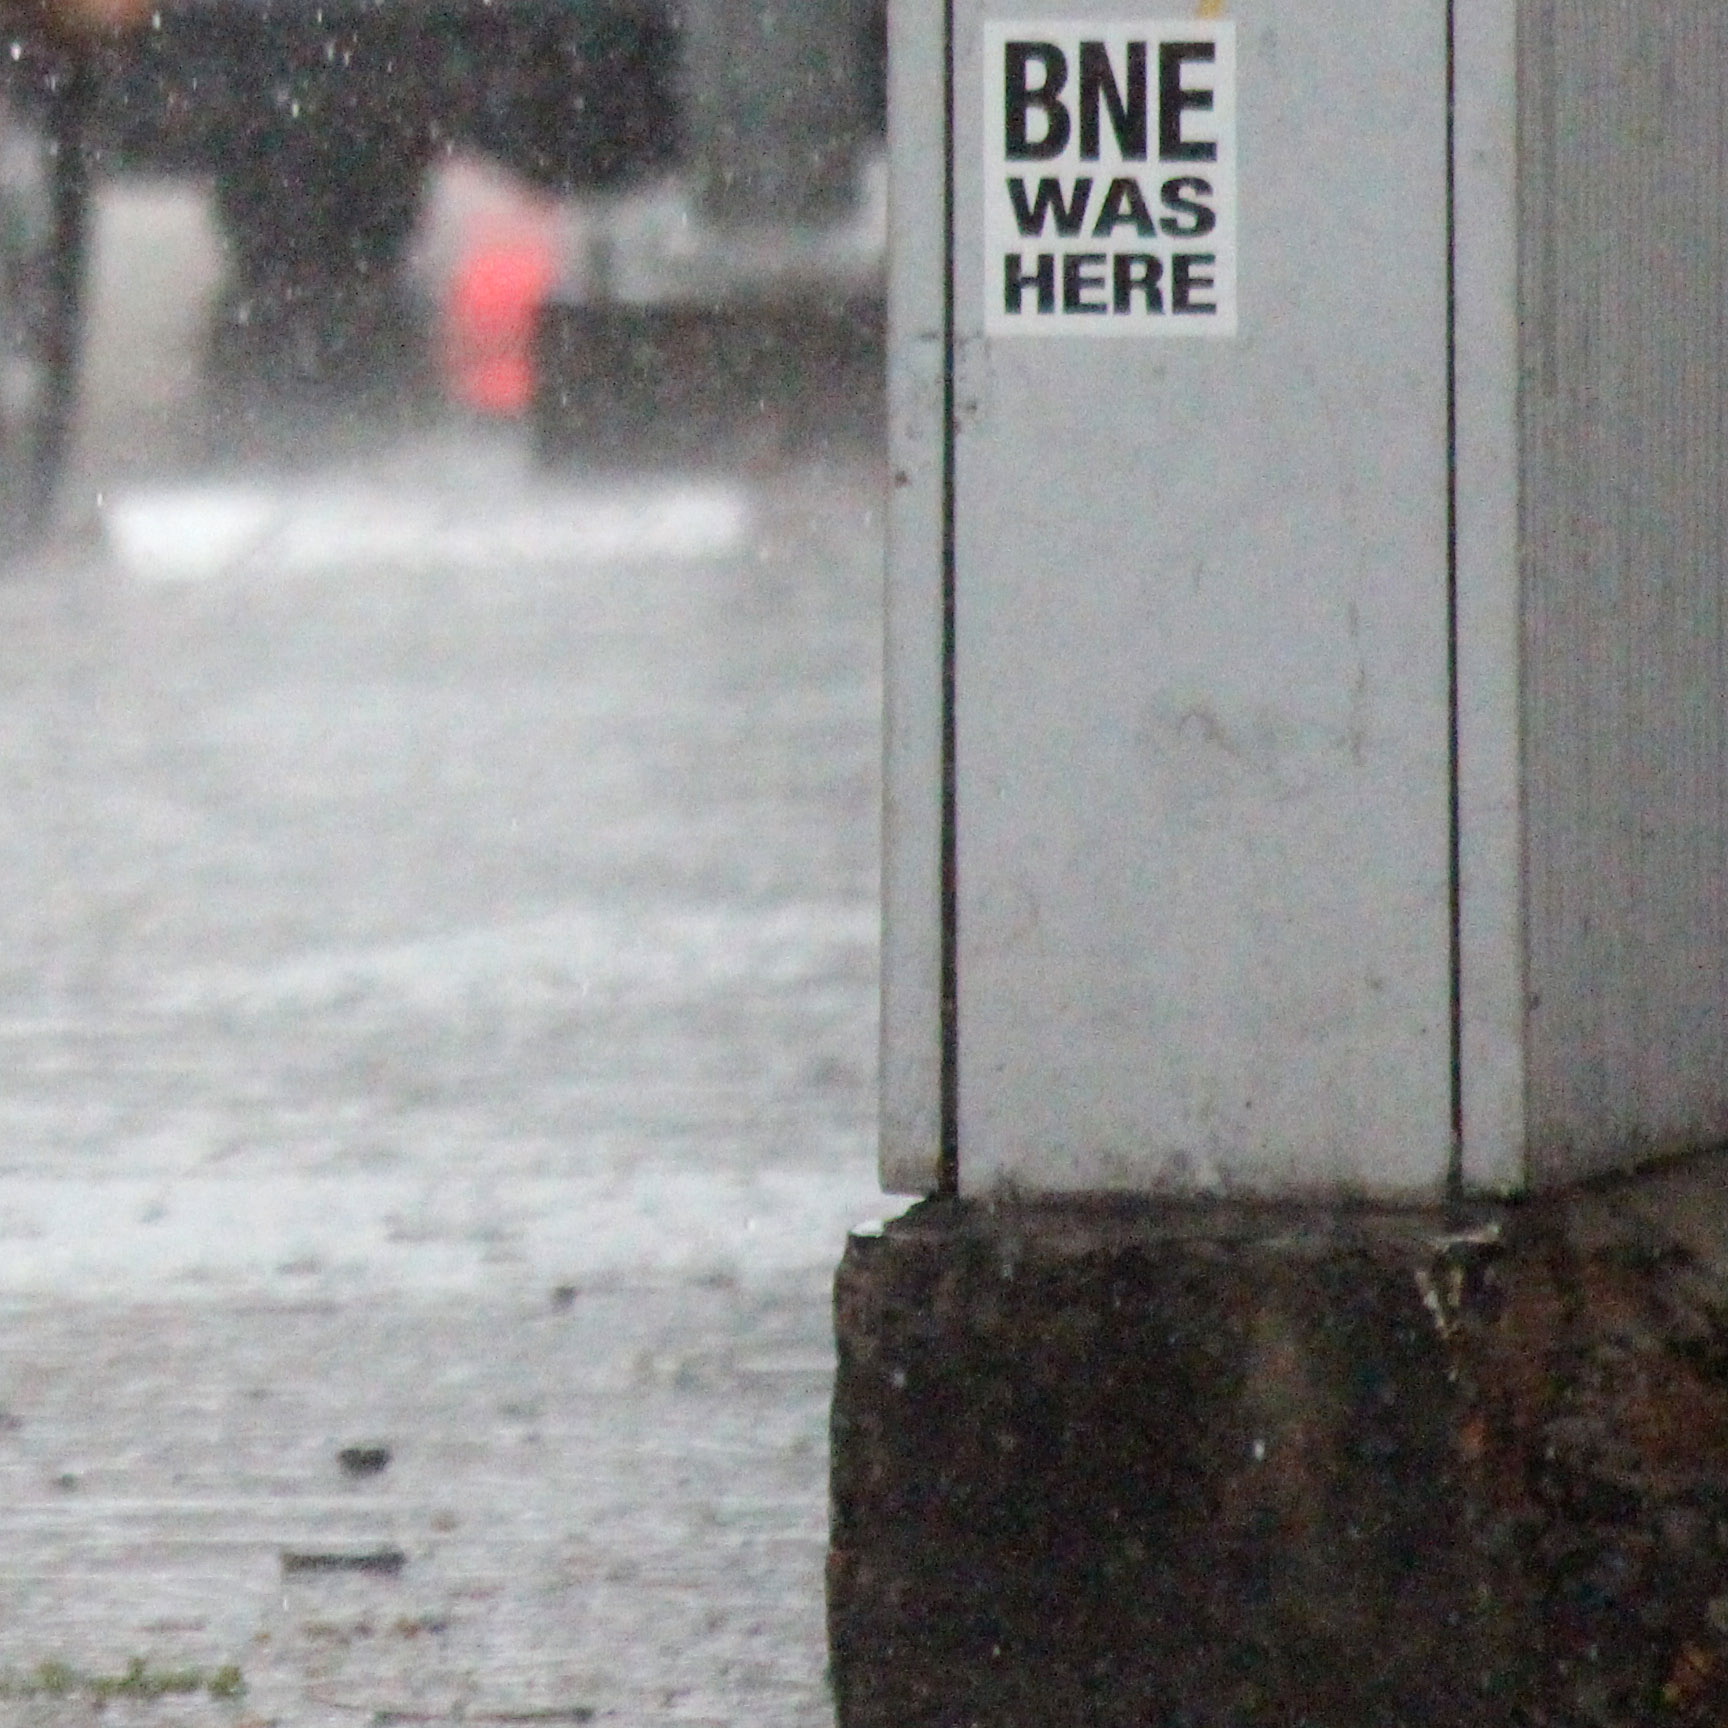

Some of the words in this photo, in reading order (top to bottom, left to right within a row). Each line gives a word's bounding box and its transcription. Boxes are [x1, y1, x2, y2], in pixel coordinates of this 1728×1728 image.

[1003, 41, 1218, 162] BNE
[1005, 177, 1217, 238] WAS
[1003, 253, 1217, 316] HERE
